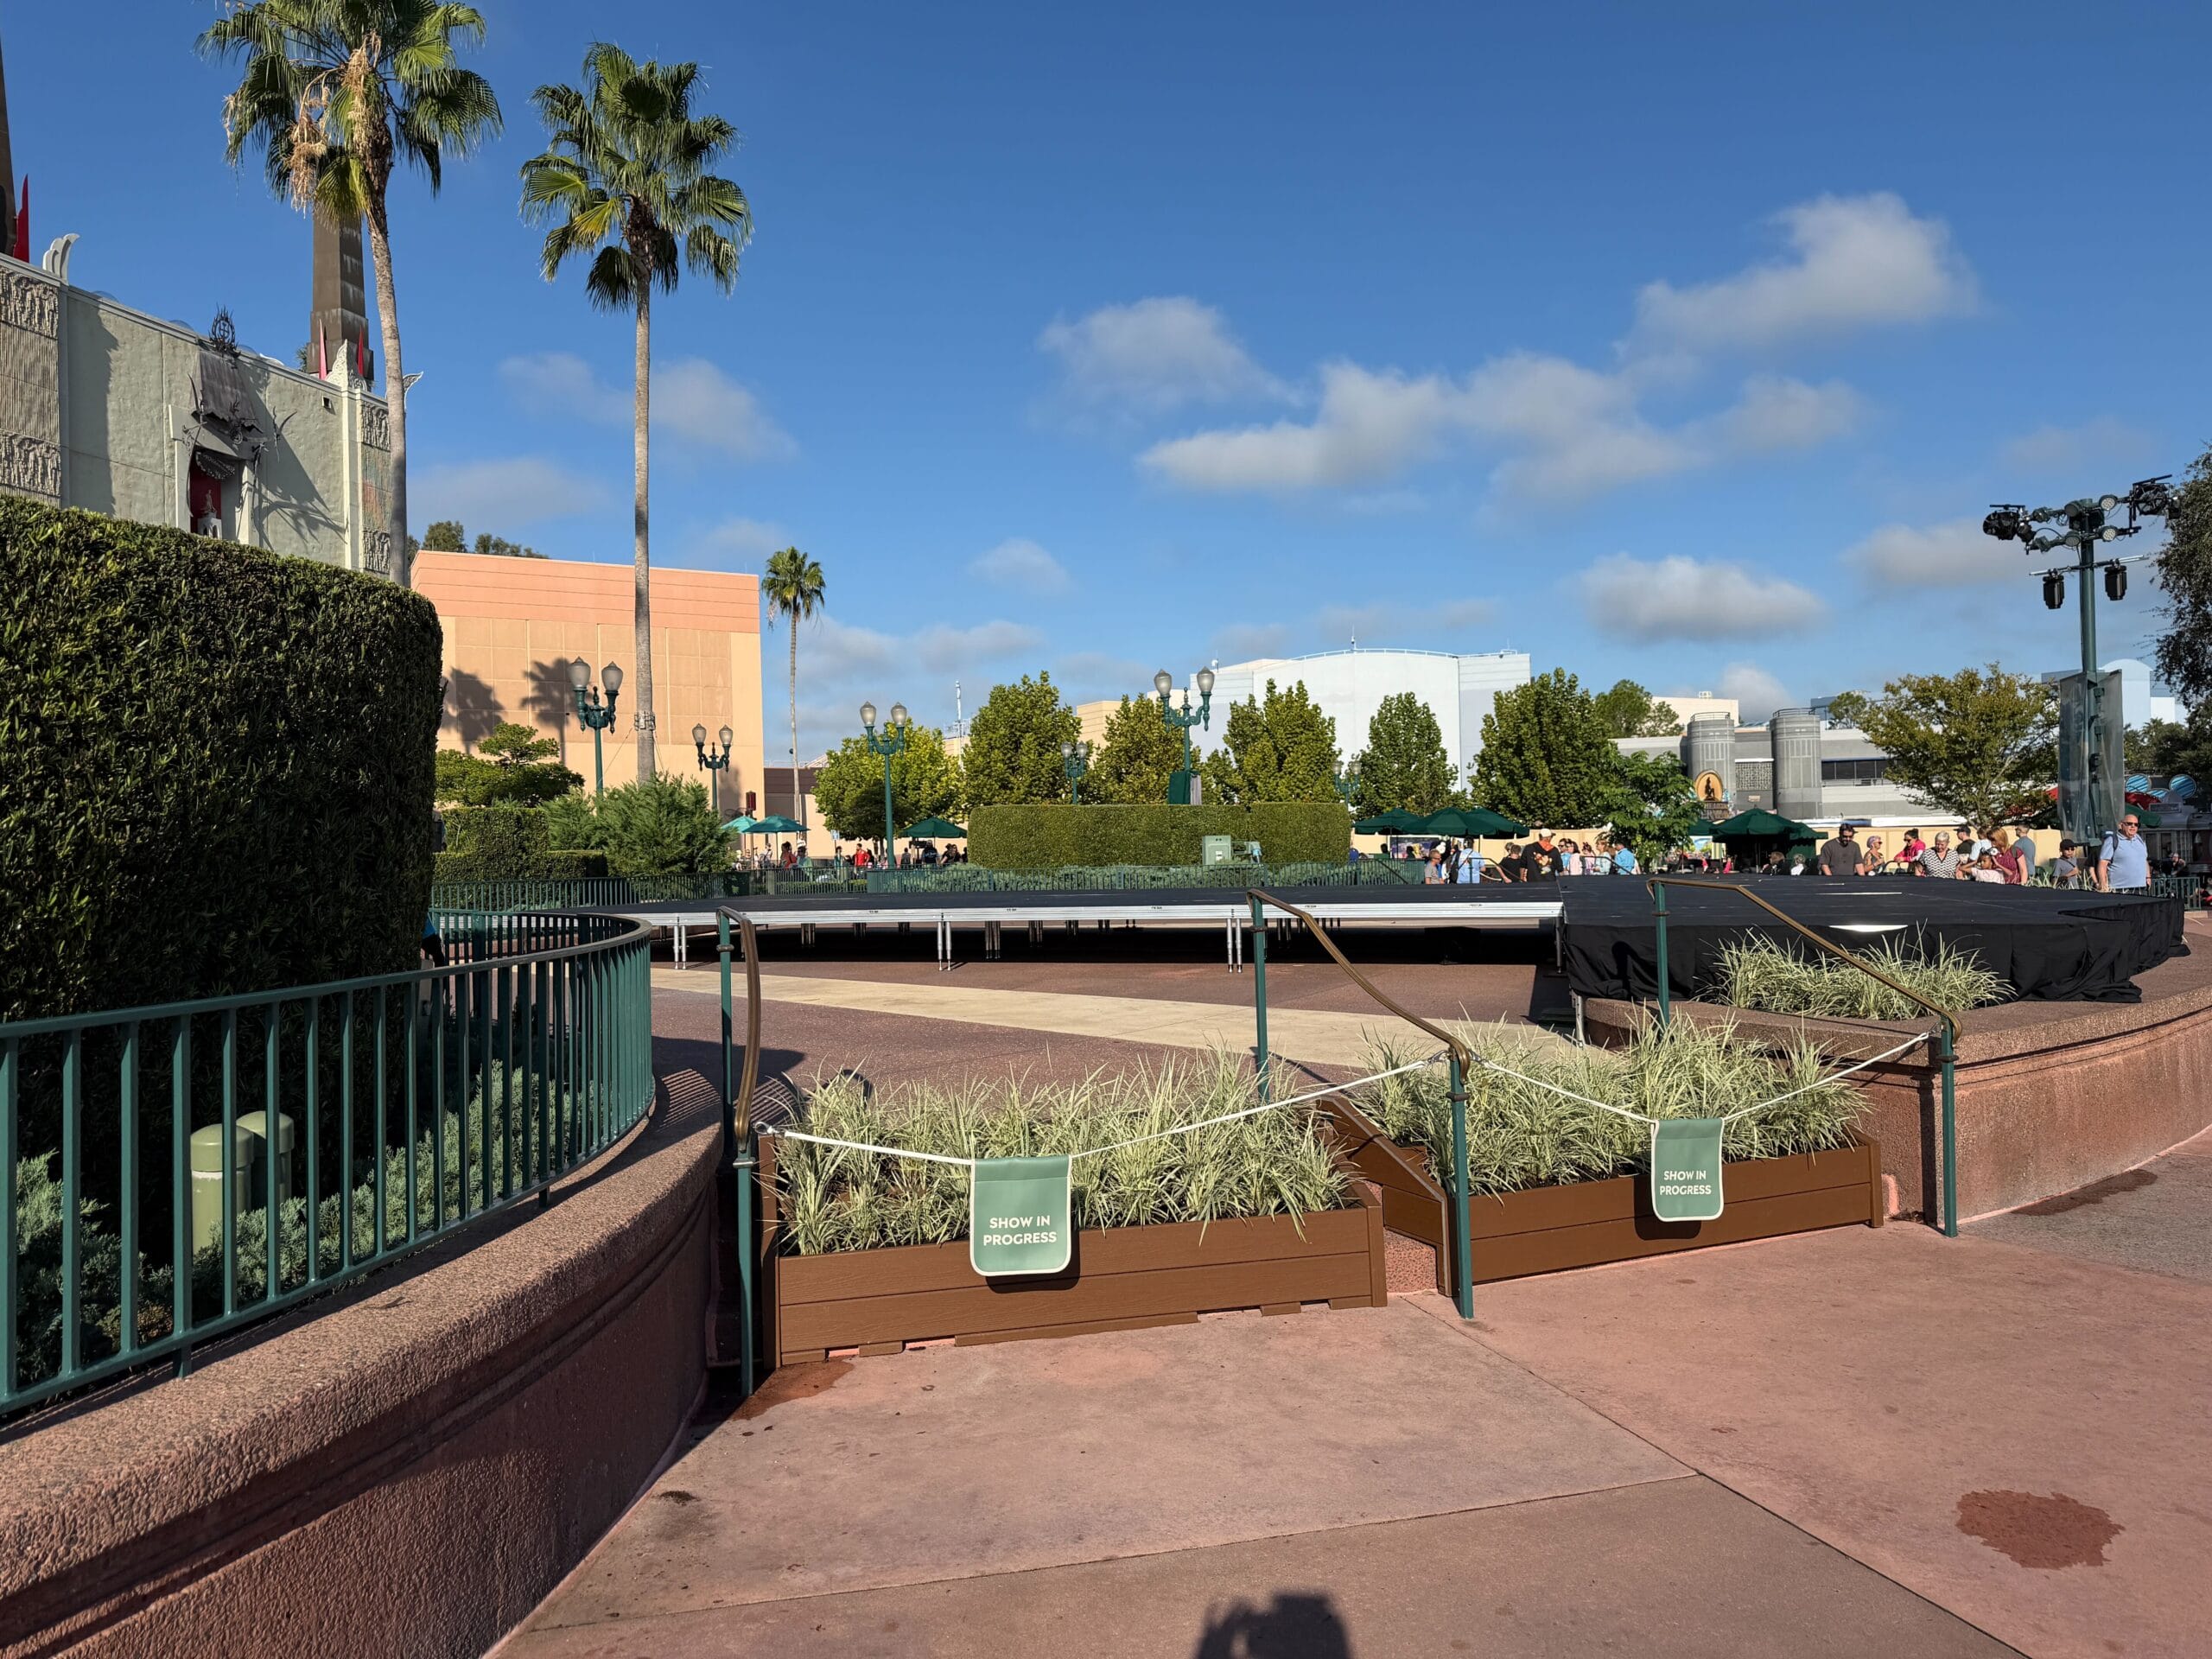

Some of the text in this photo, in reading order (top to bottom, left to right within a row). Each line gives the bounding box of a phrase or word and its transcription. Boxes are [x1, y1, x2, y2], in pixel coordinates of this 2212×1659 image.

[1663, 1170, 1707, 1181] SHOW IN
[1659, 1185, 1712, 1196] PROGRESS
[989, 1215, 1051, 1229] SHOW IN
[983, 1231, 1058, 1246] PROGRESS
